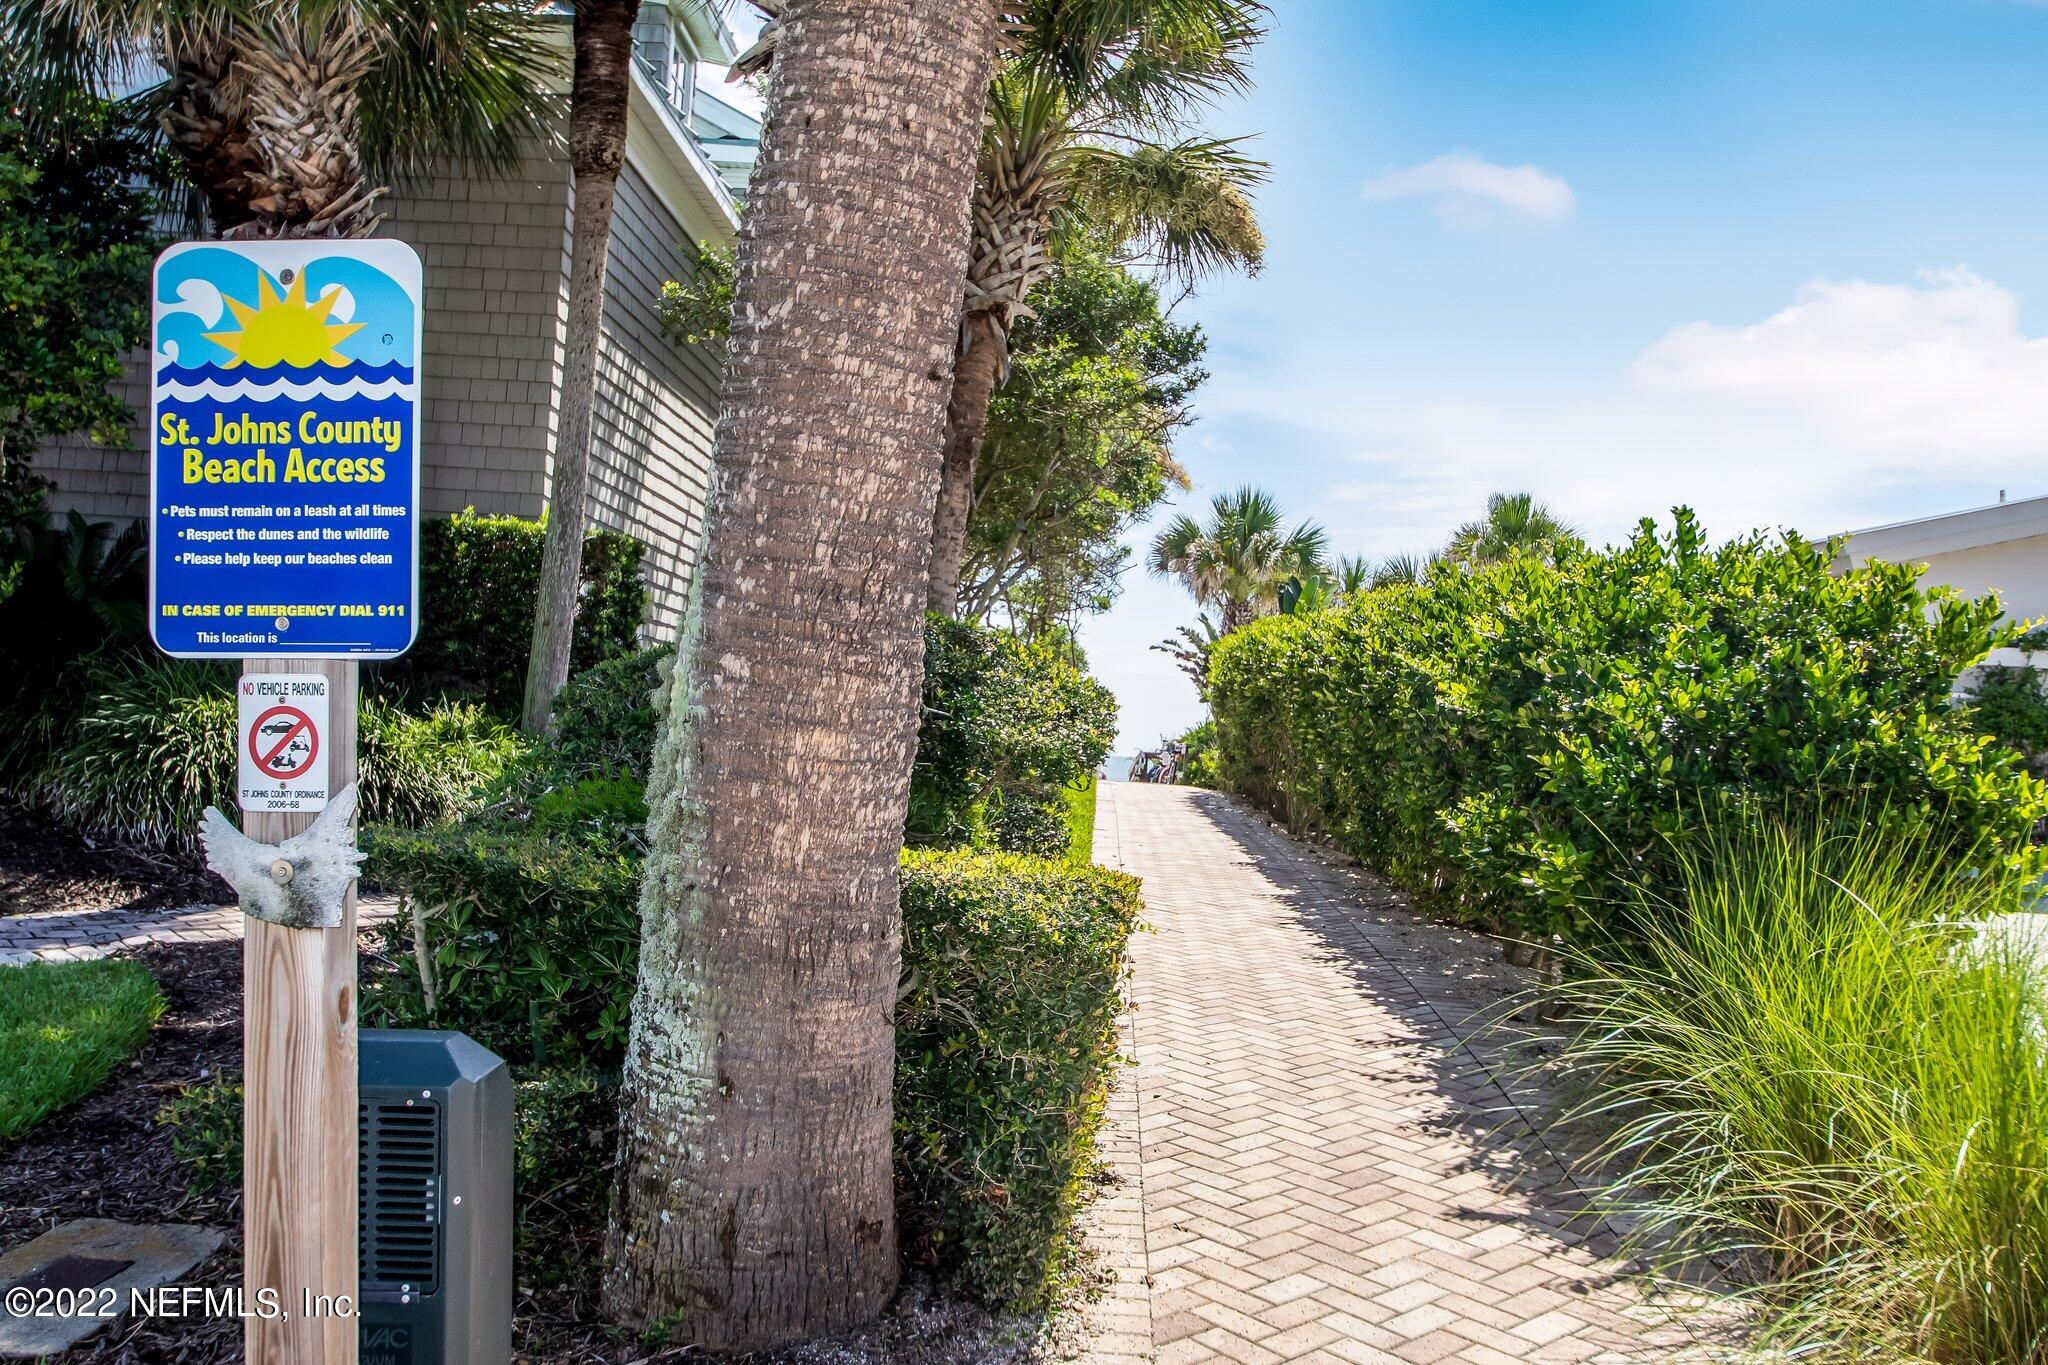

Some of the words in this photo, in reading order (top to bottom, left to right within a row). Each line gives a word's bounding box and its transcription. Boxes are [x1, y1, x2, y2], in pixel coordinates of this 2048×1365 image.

[160, 413, 199, 445] St.
[207, 413, 291, 445] Johns
[298, 411, 401, 453] County
[183, 448, 275, 484] Beach
[284, 448, 386, 483] Access
[171, 505, 196, 517] Pets
[199, 505, 229, 517] must
[232, 505, 272, 517] remain
[276, 507, 290, 516] on
[294, 507, 301, 516] a
[305, 505, 336, 516] leash
[339, 505, 352, 516] at
[354, 505, 369, 516] all
[372, 505, 406, 516] times
[187, 529, 234, 542] Respect
[236, 529, 255, 540] the
[258, 528, 294, 540] dunes
[297, 528, 319, 540] and
[322, 528, 342, 540] the
[345, 528, 389, 539] wildlife
[183, 553, 222, 564] Please
[225, 553, 250, 567] help
[253, 553, 282, 567] keep
[285, 555, 305, 564] our
[308, 552, 357, 564] beaches
[360, 552, 392, 564] clean
[162, 605, 178, 616] IN
[182, 605, 220, 616] CASE
[224, 605, 243, 616] OF
[247, 605, 336, 616] EMERGENCY
[340, 605, 374, 616] DIAL
[378, 605, 404, 616] 911
[197, 632, 219, 643] This
[222, 632, 264, 643] location
[268, 632, 277, 643] is
[243, 683, 254, 695] NO
[257, 683, 288, 695] VEHICLE
[292, 683, 324, 696] PARKING
[251, 790, 268, 798] JOHNS
[271, 790, 292, 798] COUNTY
[360, 1328, 408, 1349] VAC
